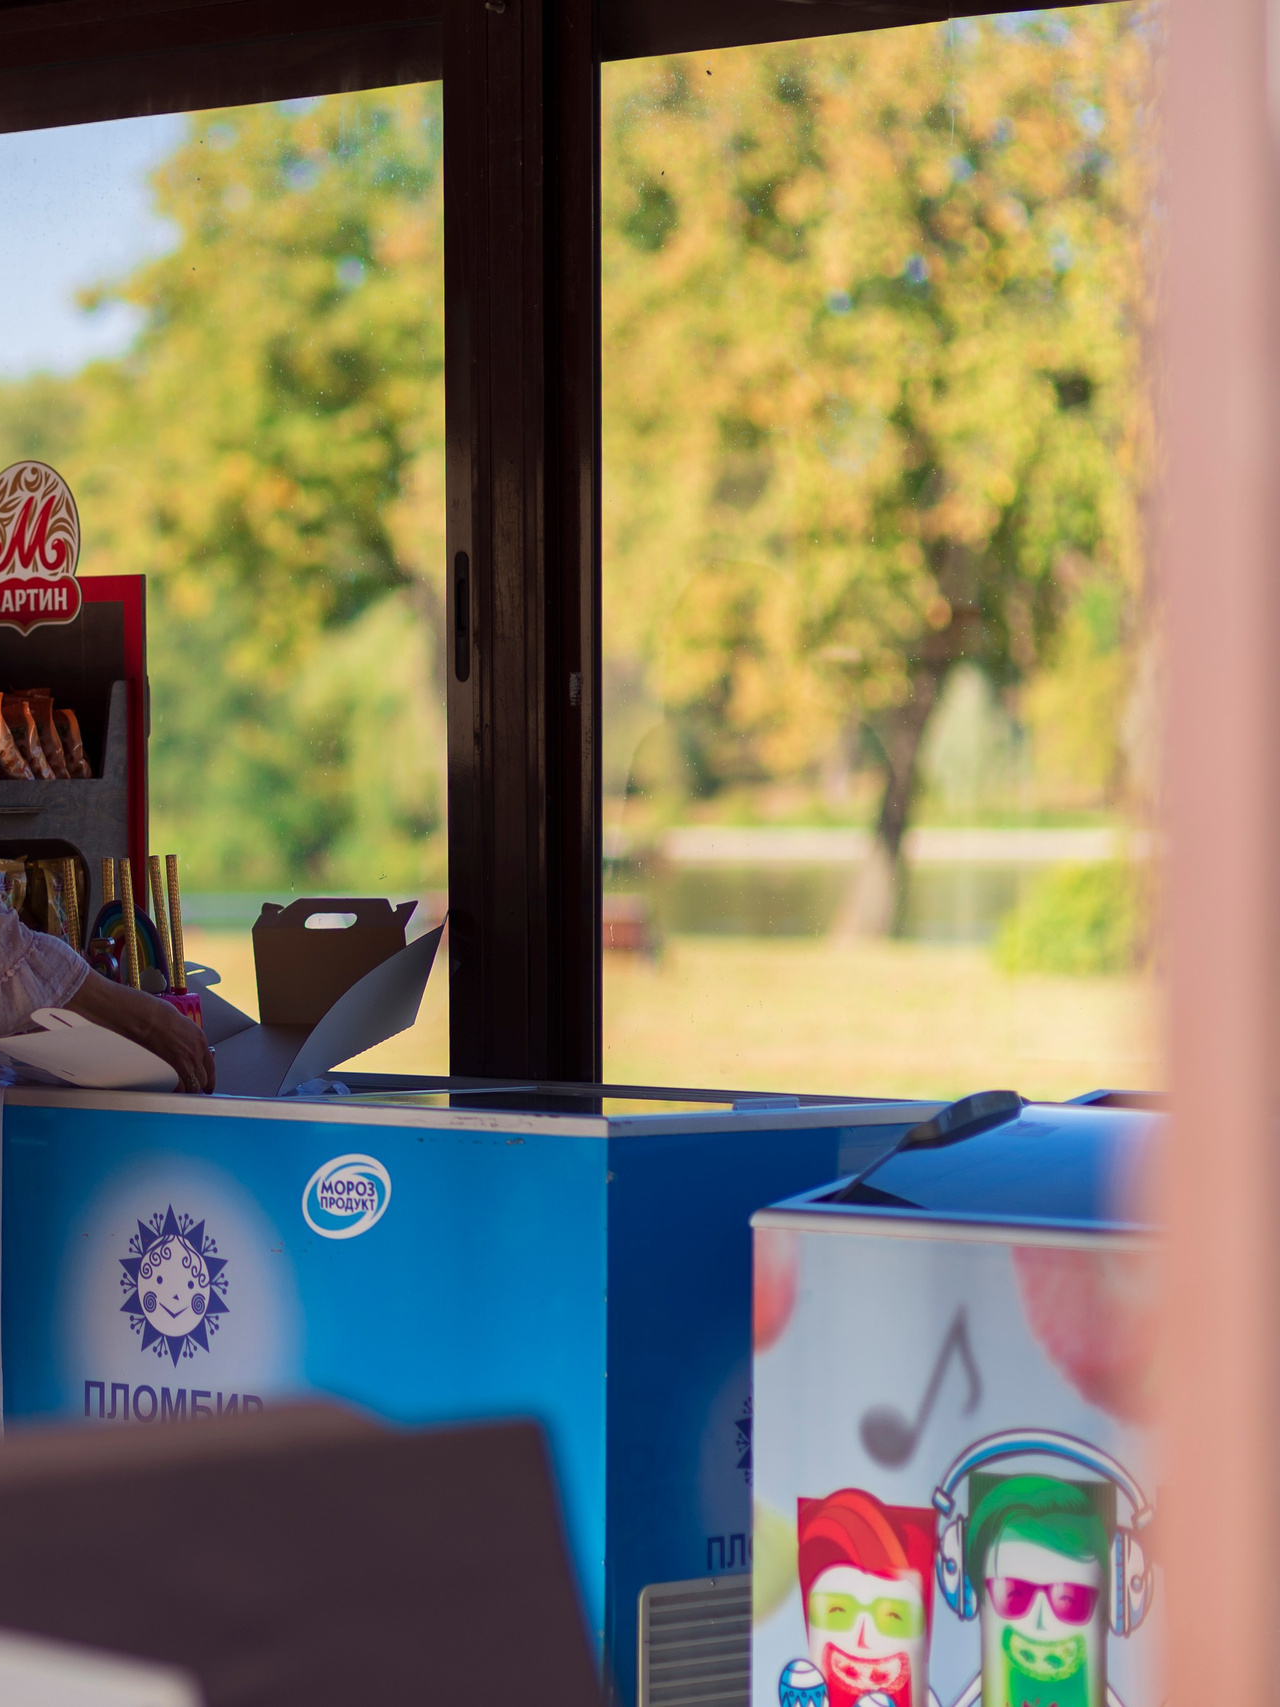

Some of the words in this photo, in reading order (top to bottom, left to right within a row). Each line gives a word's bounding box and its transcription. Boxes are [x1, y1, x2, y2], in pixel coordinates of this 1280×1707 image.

[320, 1180, 376, 1197] МОРОЗ
[320, 1196, 376, 1213] ПРОДУКТ
[707, 1533, 753, 1571] ПЛ
